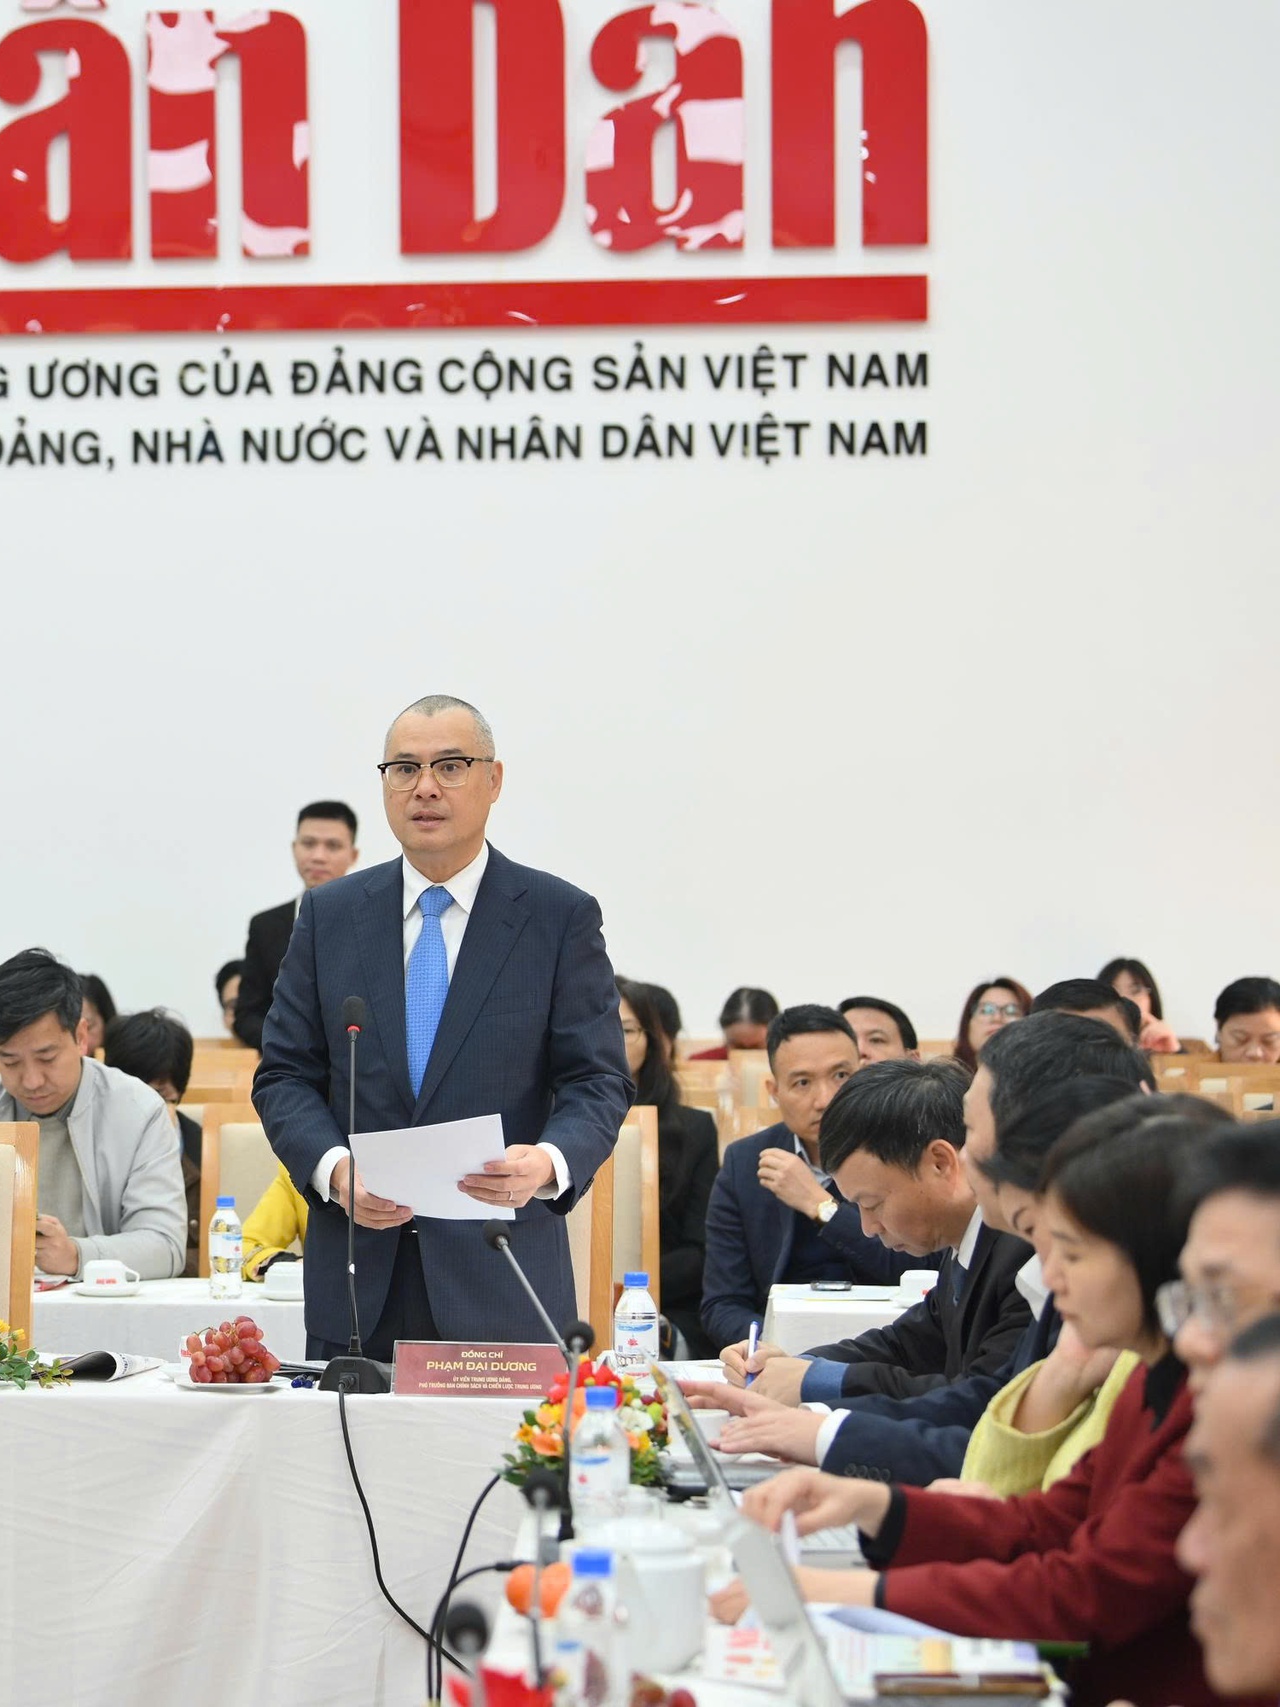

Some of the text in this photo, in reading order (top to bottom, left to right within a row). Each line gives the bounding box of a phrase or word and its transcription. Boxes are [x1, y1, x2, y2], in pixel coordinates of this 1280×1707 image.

[28, 360, 159, 399] ƯƠNG
[178, 349, 272, 397] CỦA
[290, 347, 423, 396] ĐẢNG
[438, 350, 572, 400] CỘNG
[592, 342, 686, 391] SẢN
[704, 345, 808, 396] VIỆT
[827, 353, 928, 388] NAM
[132, 420, 225, 463] NHÀ
[242, 418, 367, 463] NƯỚC
[385, 417, 443, 461] VÀ
[457, 416, 582, 460] NHÂN
[601, 414, 694, 459] DÂN
[709, 413, 811, 465] VIỆT
[828, 422, 927, 456] NAM
[426, 1361, 537, 1372] PHẠM ĐẠI DƯƠNG
